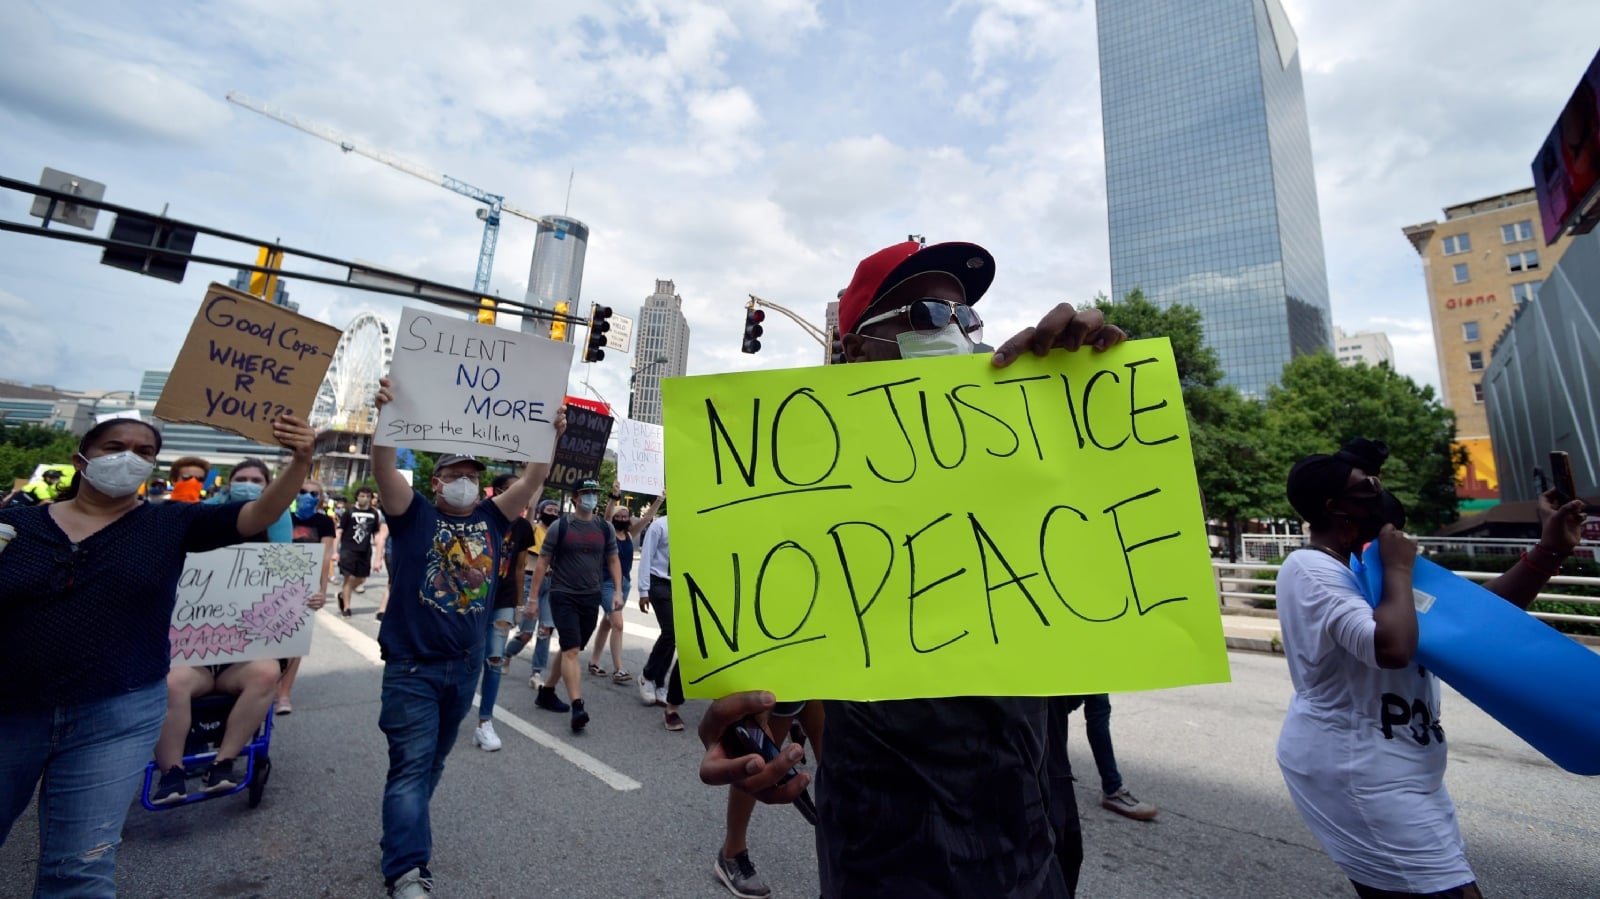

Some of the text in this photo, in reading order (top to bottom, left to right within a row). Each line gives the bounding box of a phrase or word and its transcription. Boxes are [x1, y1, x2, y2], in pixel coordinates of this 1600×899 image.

[1445, 294, 1497, 310] Glenn
[205, 296, 277, 346] Good
[400, 316, 517, 363] SILENT
[209, 339, 295, 386] WHERE
[456, 363, 500, 392] NO
[234, 374, 255, 394] R
[464, 395, 550, 424] MORE
[568, 409, 609, 433] DOWN
[704, 357, 1180, 489] NO JUSTICE
[438, 421, 464, 436] the
[472, 421, 521, 453] killing
[178, 567, 214, 604] ay
[222, 546, 271, 589] Their
[682, 487, 1189, 669] NO PEACE
[177, 600, 239, 623] ames
